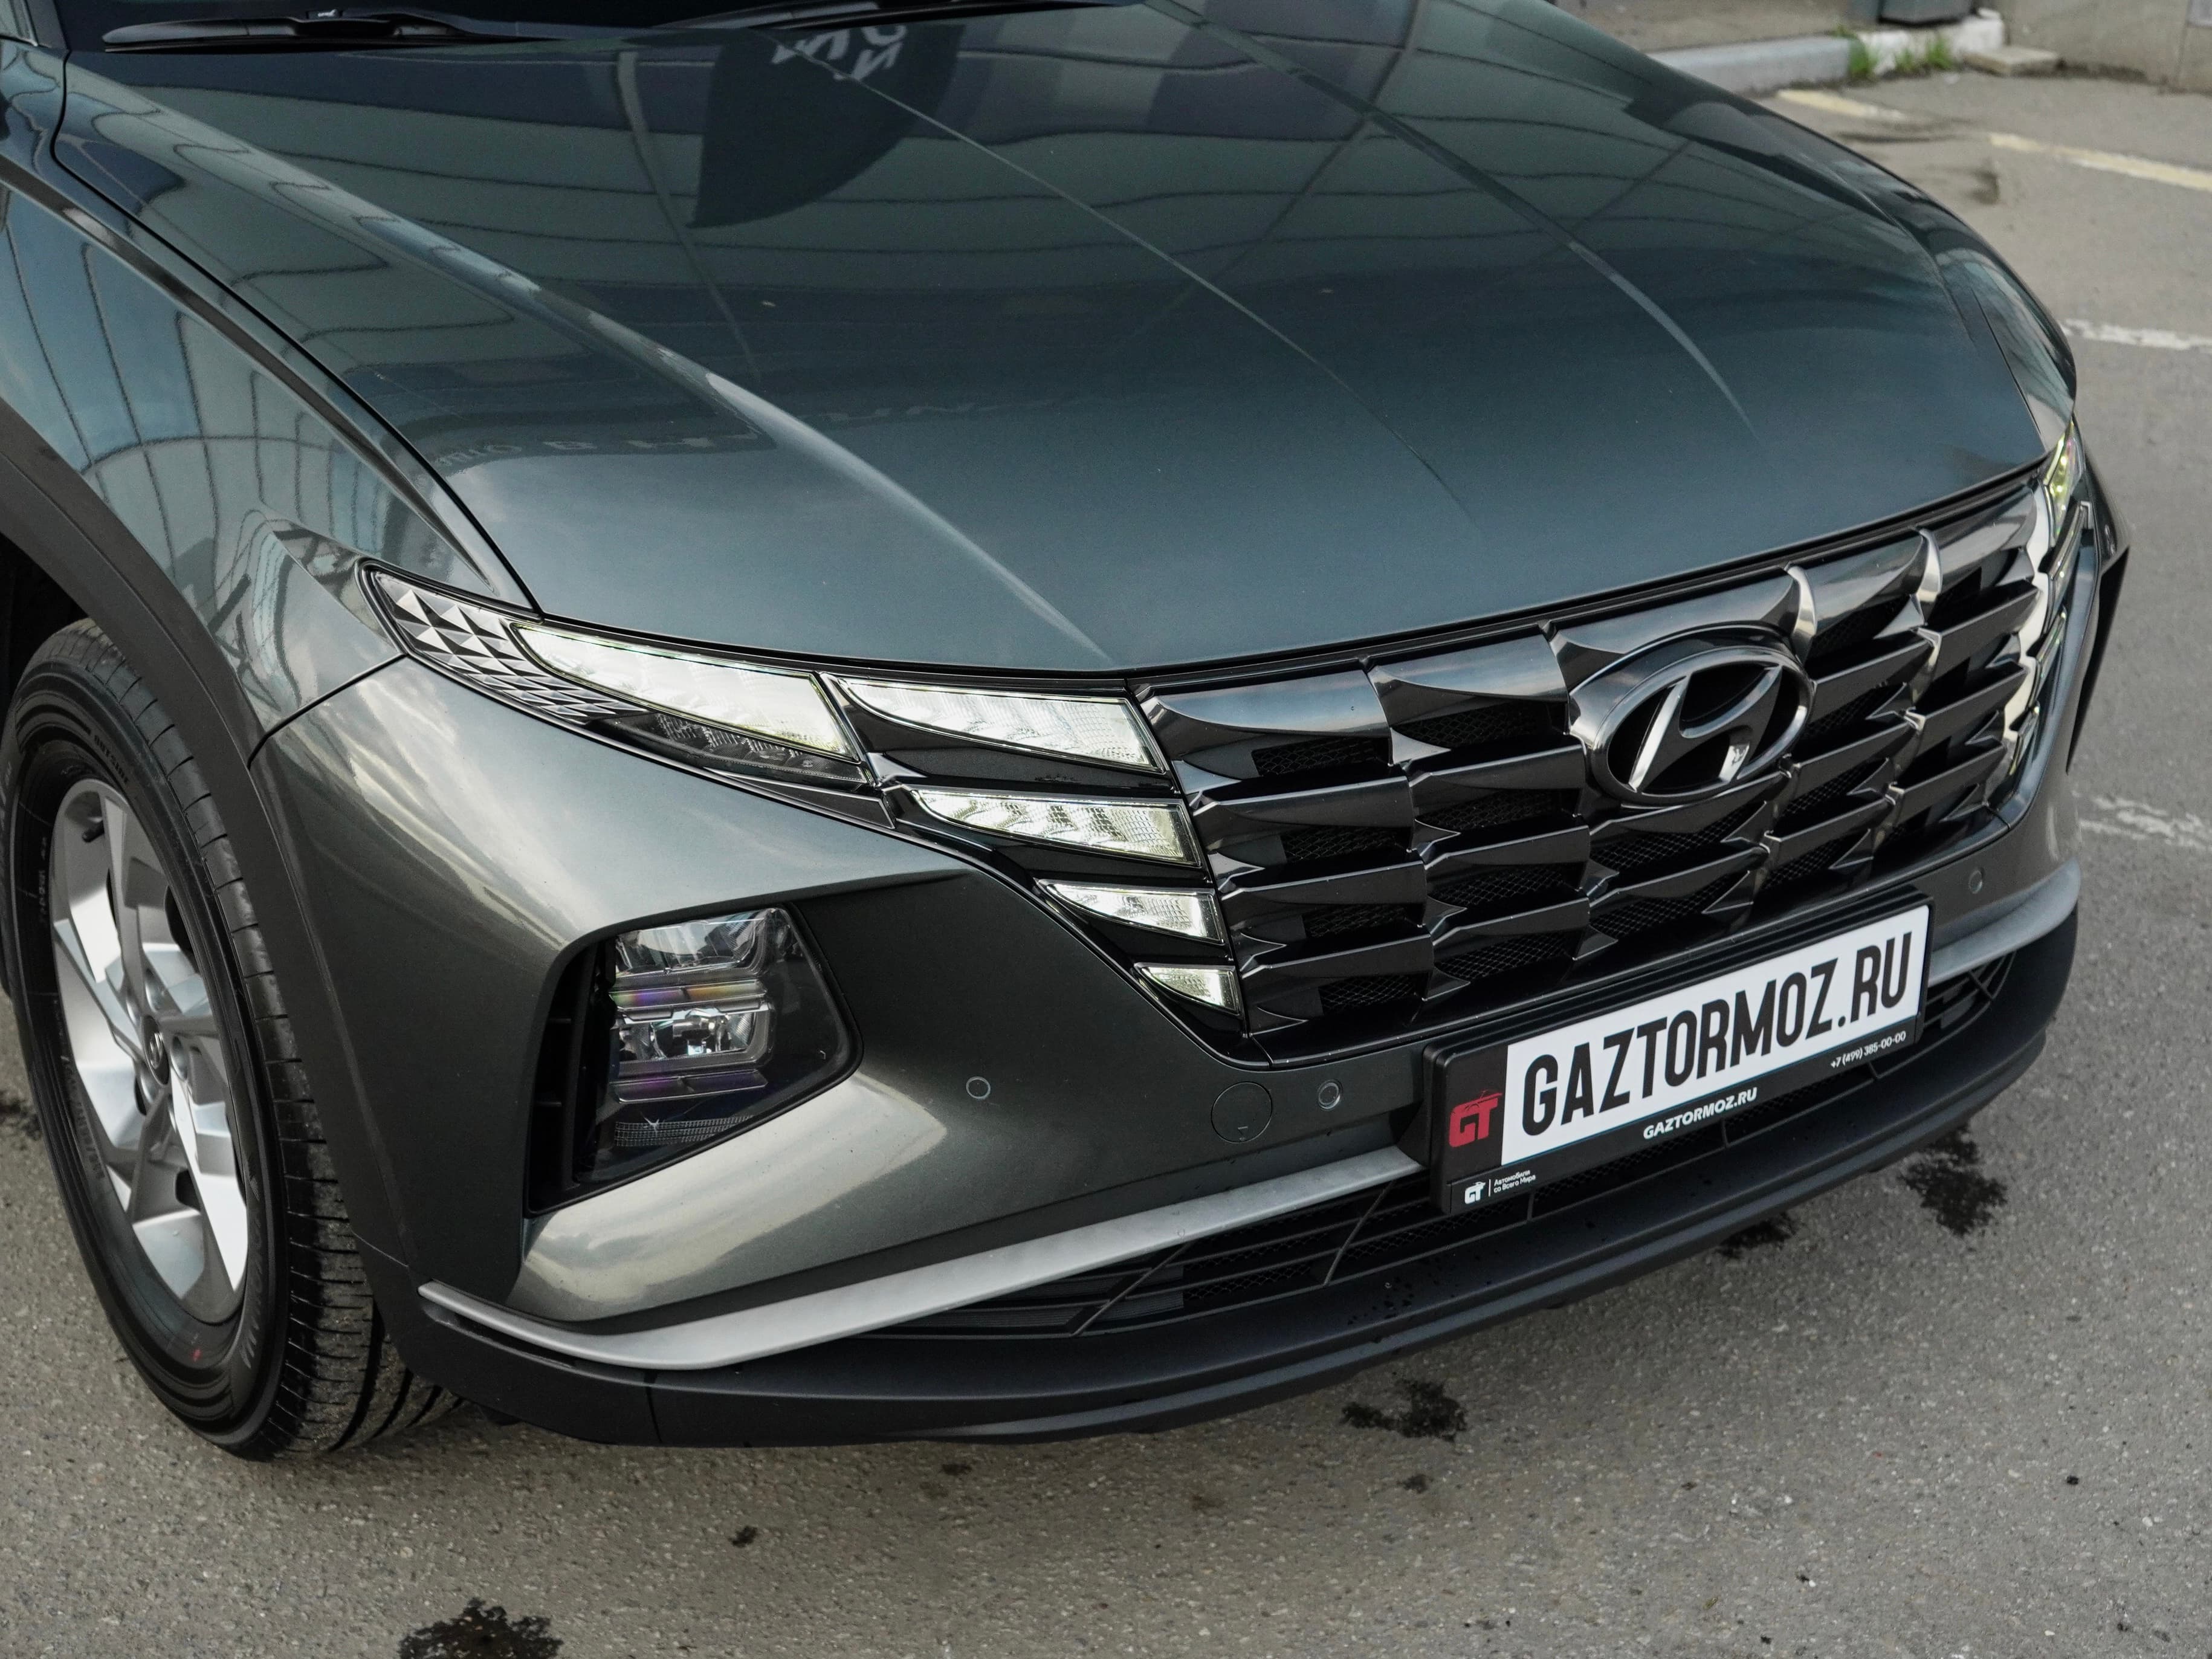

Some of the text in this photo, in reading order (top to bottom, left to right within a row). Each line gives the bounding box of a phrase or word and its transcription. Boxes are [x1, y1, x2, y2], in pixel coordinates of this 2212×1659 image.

[1521, 931, 1913, 1137] GAZTORMOZ.RU
[1842, 1047, 1863, 1066] (499)
[1864, 1030, 1906, 1056] 385-00-00
[1449, 1092, 1503, 1148] GT
[1643, 1087, 1758, 1140] GAZTORMOZ.RU
[1464, 1182, 1486, 1205] GT
[1493, 1169, 1531, 1187] Автомобили
[1502, 1180, 1519, 1191] Всего
[1519, 1174, 1536, 1185] Мира
